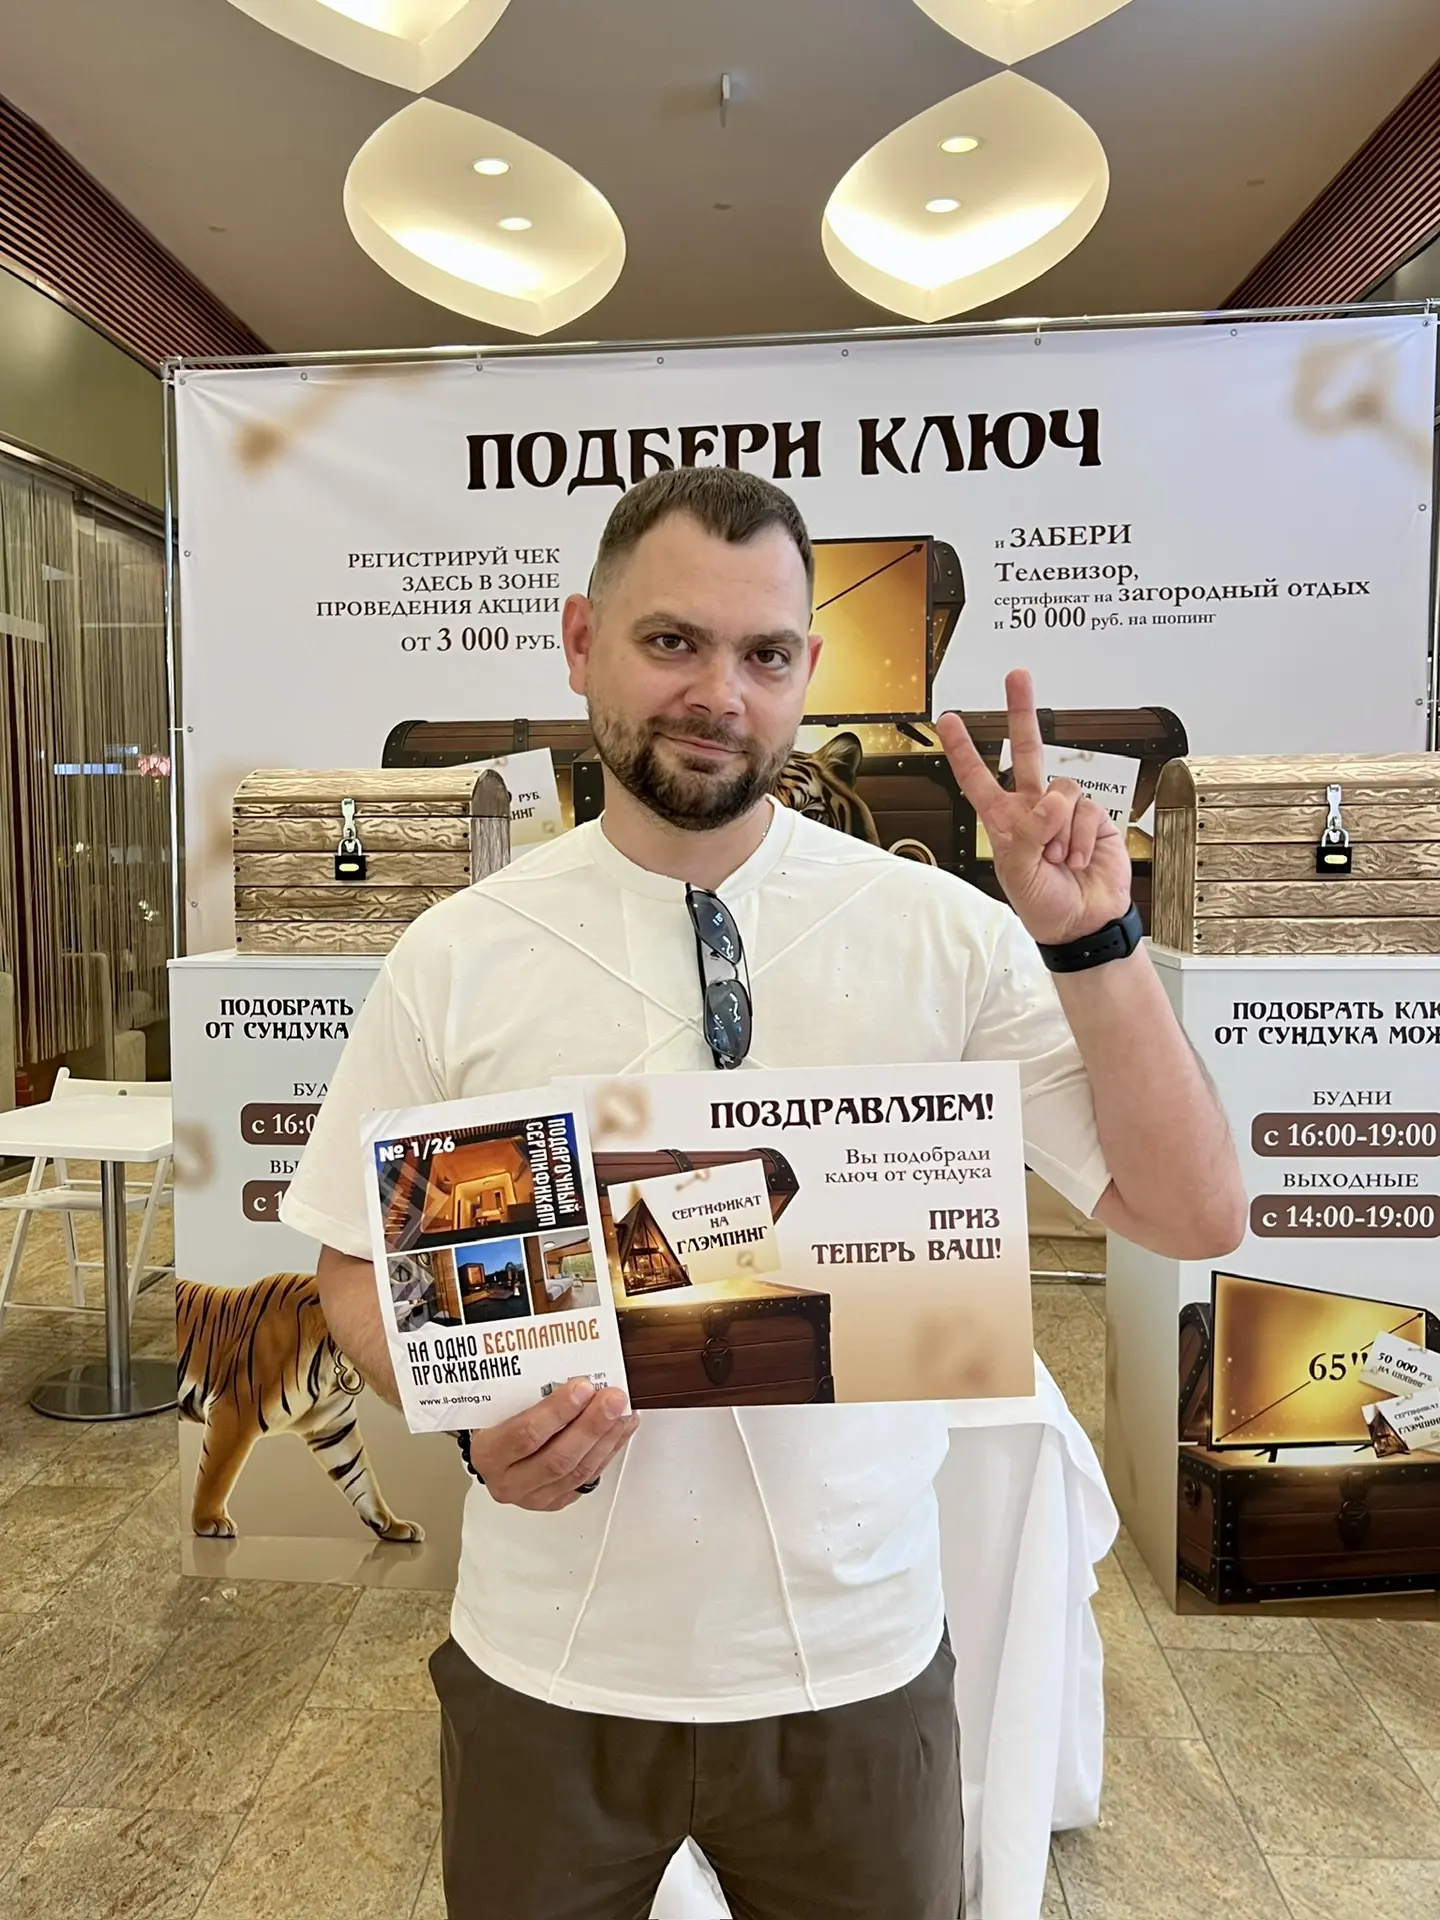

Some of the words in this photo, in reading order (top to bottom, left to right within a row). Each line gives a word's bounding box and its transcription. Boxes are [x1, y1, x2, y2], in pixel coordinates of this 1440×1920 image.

[466, 420, 822, 497] ПОДБЕРИ
[858, 408, 1102, 476] КЛЮЧ
[994, 538, 1005, 549] и
[1010, 523, 1132, 549] ЗАБЕРИ
[348, 546, 508, 569] РЕГИСТРИРУЙ
[515, 548, 560, 565] ЧЕК
[402, 575, 473, 594] ЗДЕСЬ
[479, 574, 493, 591] В
[498, 573, 560, 590] ЗОНЕ
[995, 562, 1140, 586] Телевизор,
[994, 591, 1088, 608] сертификат
[1094, 590, 1113, 604] на
[1118, 578, 1279, 605] загородный
[1287, 580, 1371, 599] отдых
[316, 600, 472, 618] ПРОВЕДЕНИЯ
[478, 597, 560, 615] АКЦИИ
[994, 620, 1004, 630] и
[1009, 607, 1037, 630] 50
[1044, 606, 1086, 629] 000
[1091, 614, 1123, 631] руб.
[1128, 614, 1147, 627] на
[1151, 611, 1217, 626] шопинг
[401, 636, 431, 652] ОТ
[436, 627, 452, 652] 3
[461, 627, 509, 652] 000
[516, 634, 561, 651] РУБ.
[220, 999, 354, 1018] ПОДОБРАТЬ
[1232, 1001, 1384, 1022] ПОДОБРАТЬ
[205, 1022, 234, 1039] ОТ
[243, 1021, 349, 1041] СУНДУКА
[1214, 1026, 1248, 1045] ОТ
[1258, 1026, 1378, 1046] СУНДУКА
[1389, 1026, 1440, 1044] МОЖ
[293, 1083, 328, 1098] БУД
[1312, 1091, 1392, 1107] БУДНИ
[710, 1093, 994, 1130] ПОЗДРАВЛЯЕМ!
[1264, 1129, 1279, 1146] с
[1287, 1122, 1437, 1147] 16:00-19:00
[379, 1144, 404, 1162] №
[411, 1136, 456, 1160] 1/26
[845, 1149, 876, 1165] Вы
[884, 1147, 990, 1167] подобрали
[526, 1121, 556, 1227] СЕРТИФИКАТ
[547, 1118, 582, 1215] ПОДАРОЧНЫЙ
[824, 1171, 878, 1184] ключ
[885, 1170, 906, 1182] от
[912, 1167, 992, 1184] сундука
[1283, 1173, 1419, 1189] ВЫХОДНЫЕ
[672, 1195, 761, 1220] СЕРТИФИКАТ
[929, 1208, 1001, 1230] ПРИЗ
[1262, 1211, 1278, 1228] с
[1286, 1205, 1435, 1229] 14:00-19:00
[710, 1216, 729, 1228] НА
[677, 1226, 768, 1255] ГЛЭМПИНГ
[811, 1241, 916, 1265] ТЕПЕРЬ
[927, 1237, 1001, 1261] ВАШ!
[407, 1341, 430, 1362] НА
[434, 1335, 478, 1362] ОДНО
[483, 1318, 600, 1355] БЕСПЛАТНОЕ
[411, 1355, 521, 1386] ПРОЖИВАНИЕ
[1378, 1352, 1393, 1364] 50
[1395, 1359, 1418, 1374] 000
